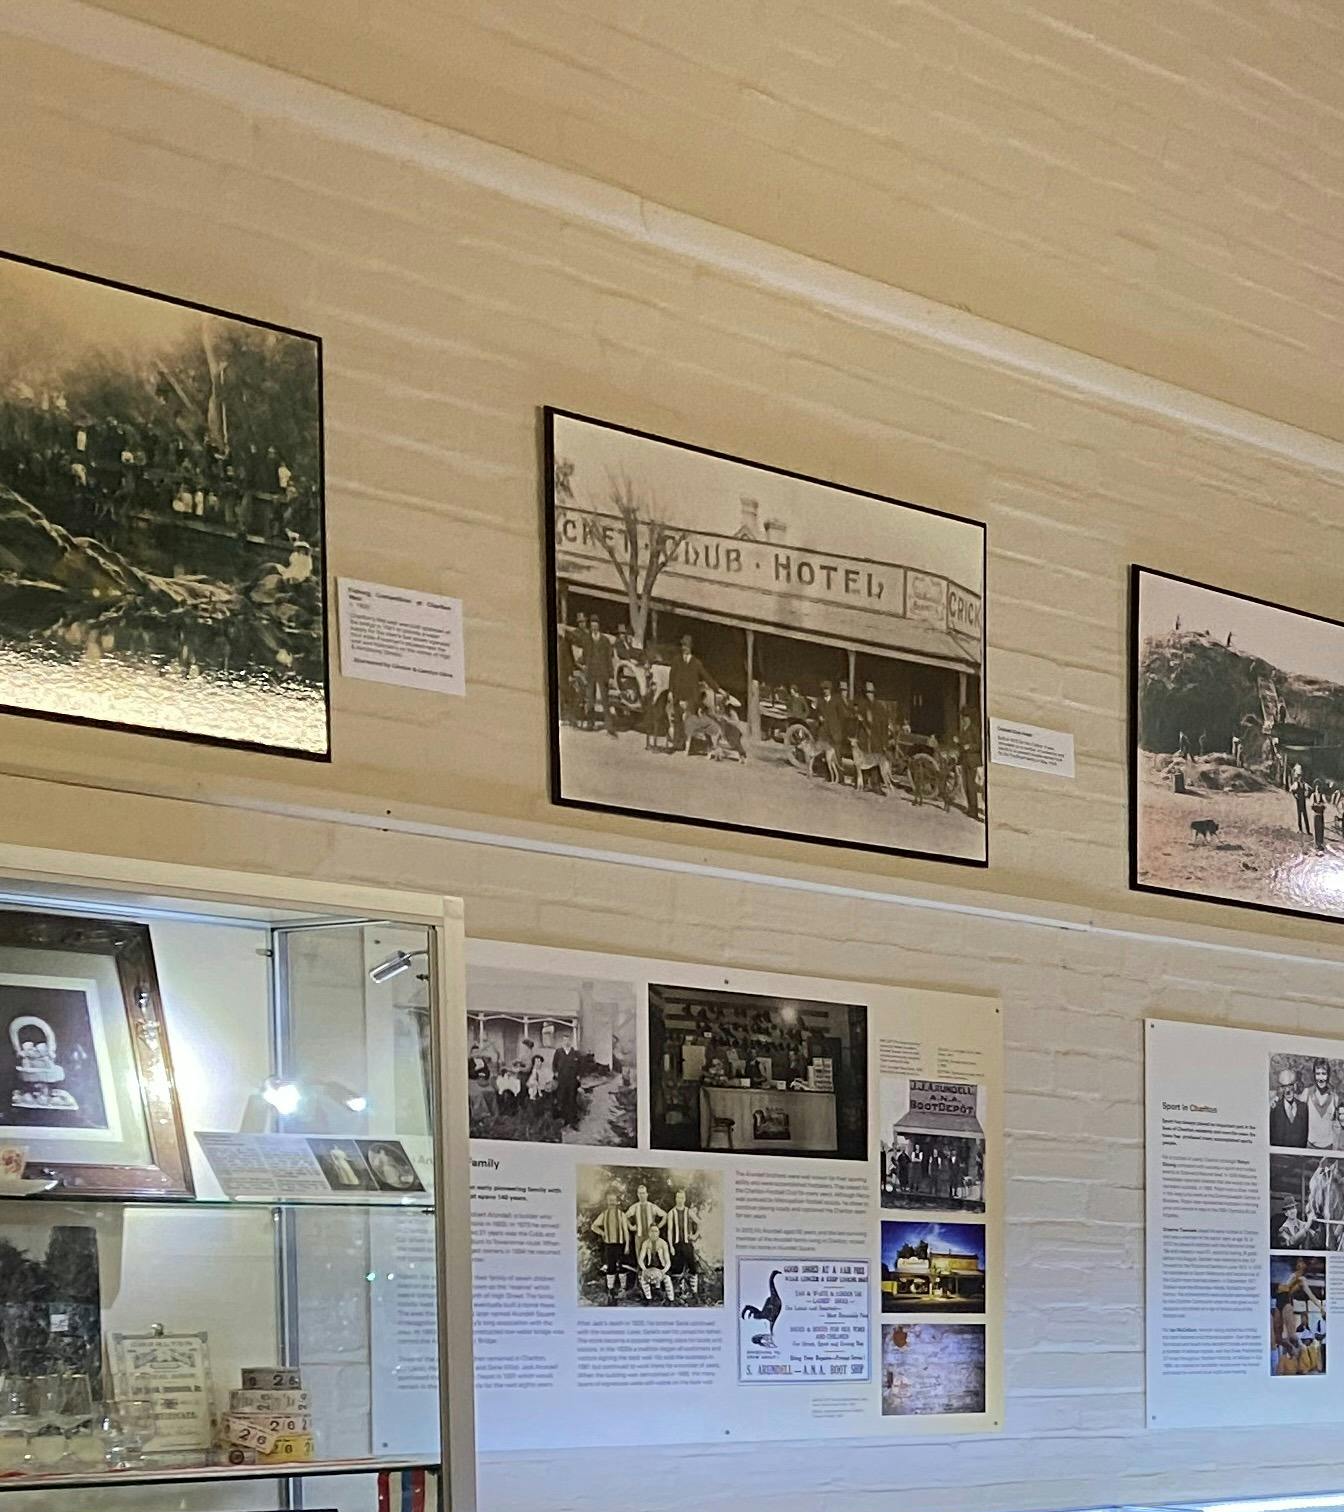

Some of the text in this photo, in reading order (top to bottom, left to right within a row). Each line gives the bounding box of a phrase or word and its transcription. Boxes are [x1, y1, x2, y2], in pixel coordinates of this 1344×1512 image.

[661, 534, 742, 572] CLUB
[774, 553, 884, 600] HOTEL
[1162, 1102, 1181, 1111] Sport
[470, 1158, 500, 1170] amily
